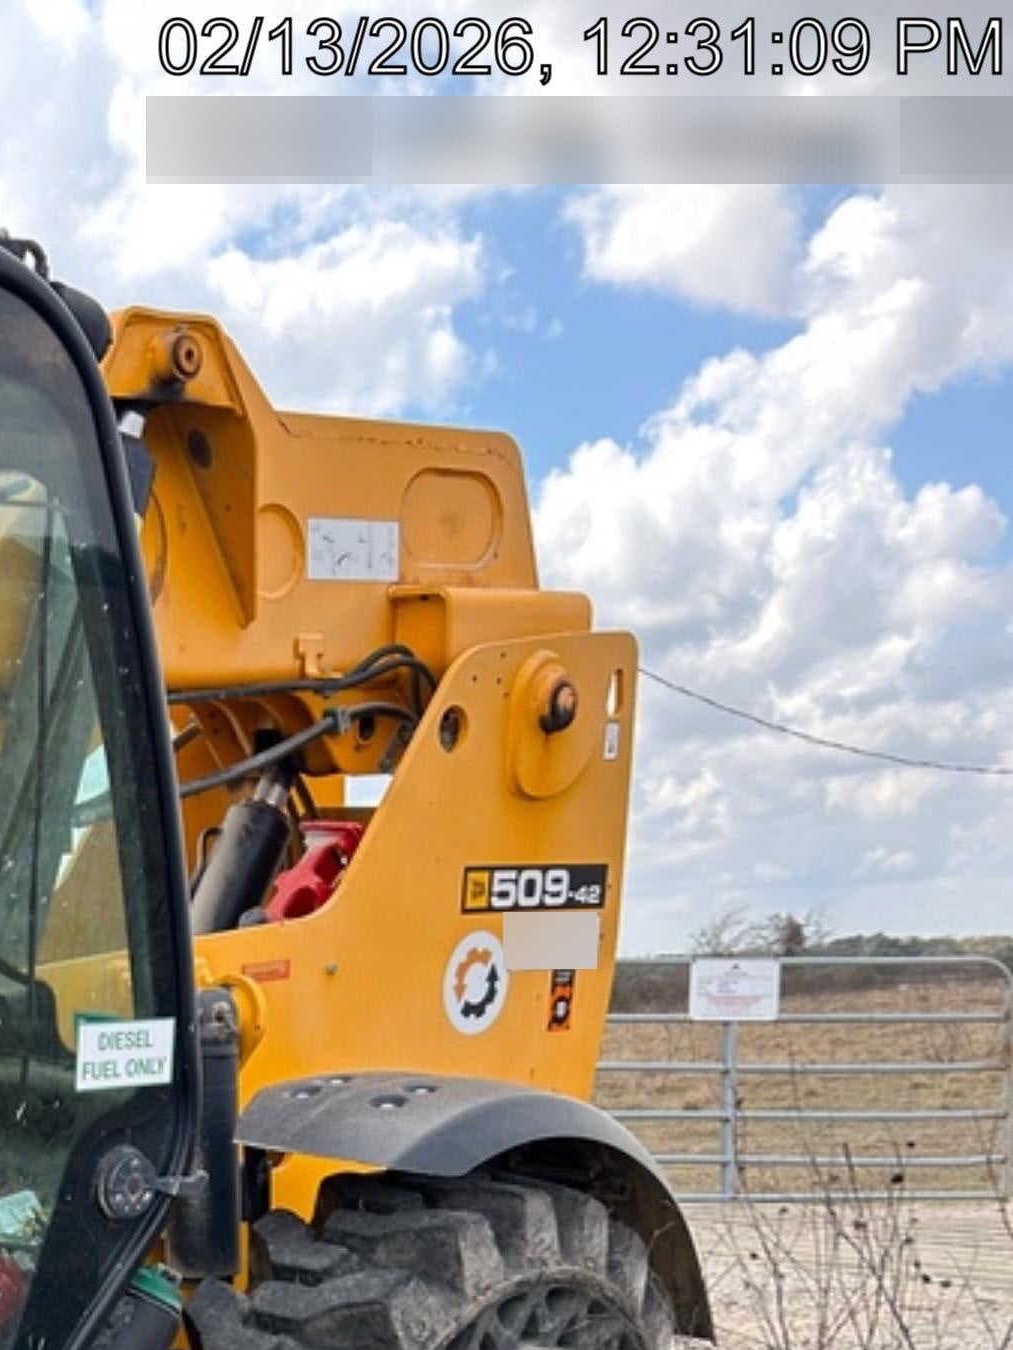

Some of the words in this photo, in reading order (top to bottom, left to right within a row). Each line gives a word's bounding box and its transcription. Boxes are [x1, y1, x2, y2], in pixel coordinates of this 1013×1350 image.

[97, 1029, 153, 1051] DIESEL
[83, 1060, 120, 1080] FUEL
[125, 1057, 168, 1078] ONLY
